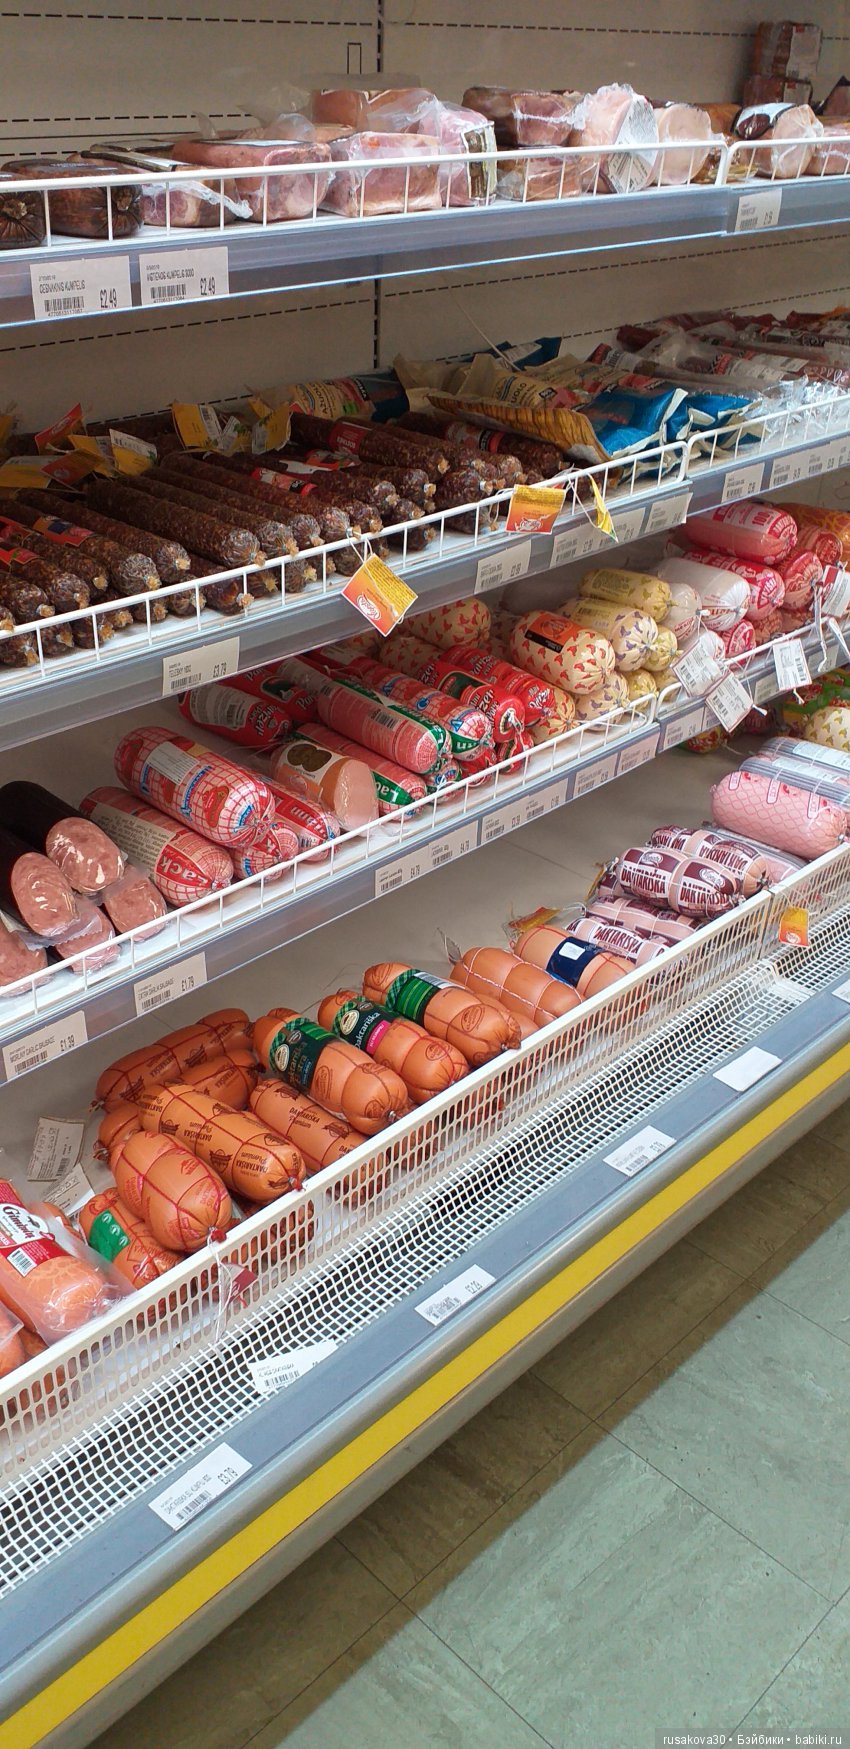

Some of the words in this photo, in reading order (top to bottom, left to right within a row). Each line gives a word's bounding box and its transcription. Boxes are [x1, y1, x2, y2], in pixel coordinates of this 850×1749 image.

[200, 277, 216, 296] £2.49
[100, 289, 117, 308] £2.49
[60, 1034, 75, 1052] £1.39
[217, 1467, 238, 1485] £3.79
